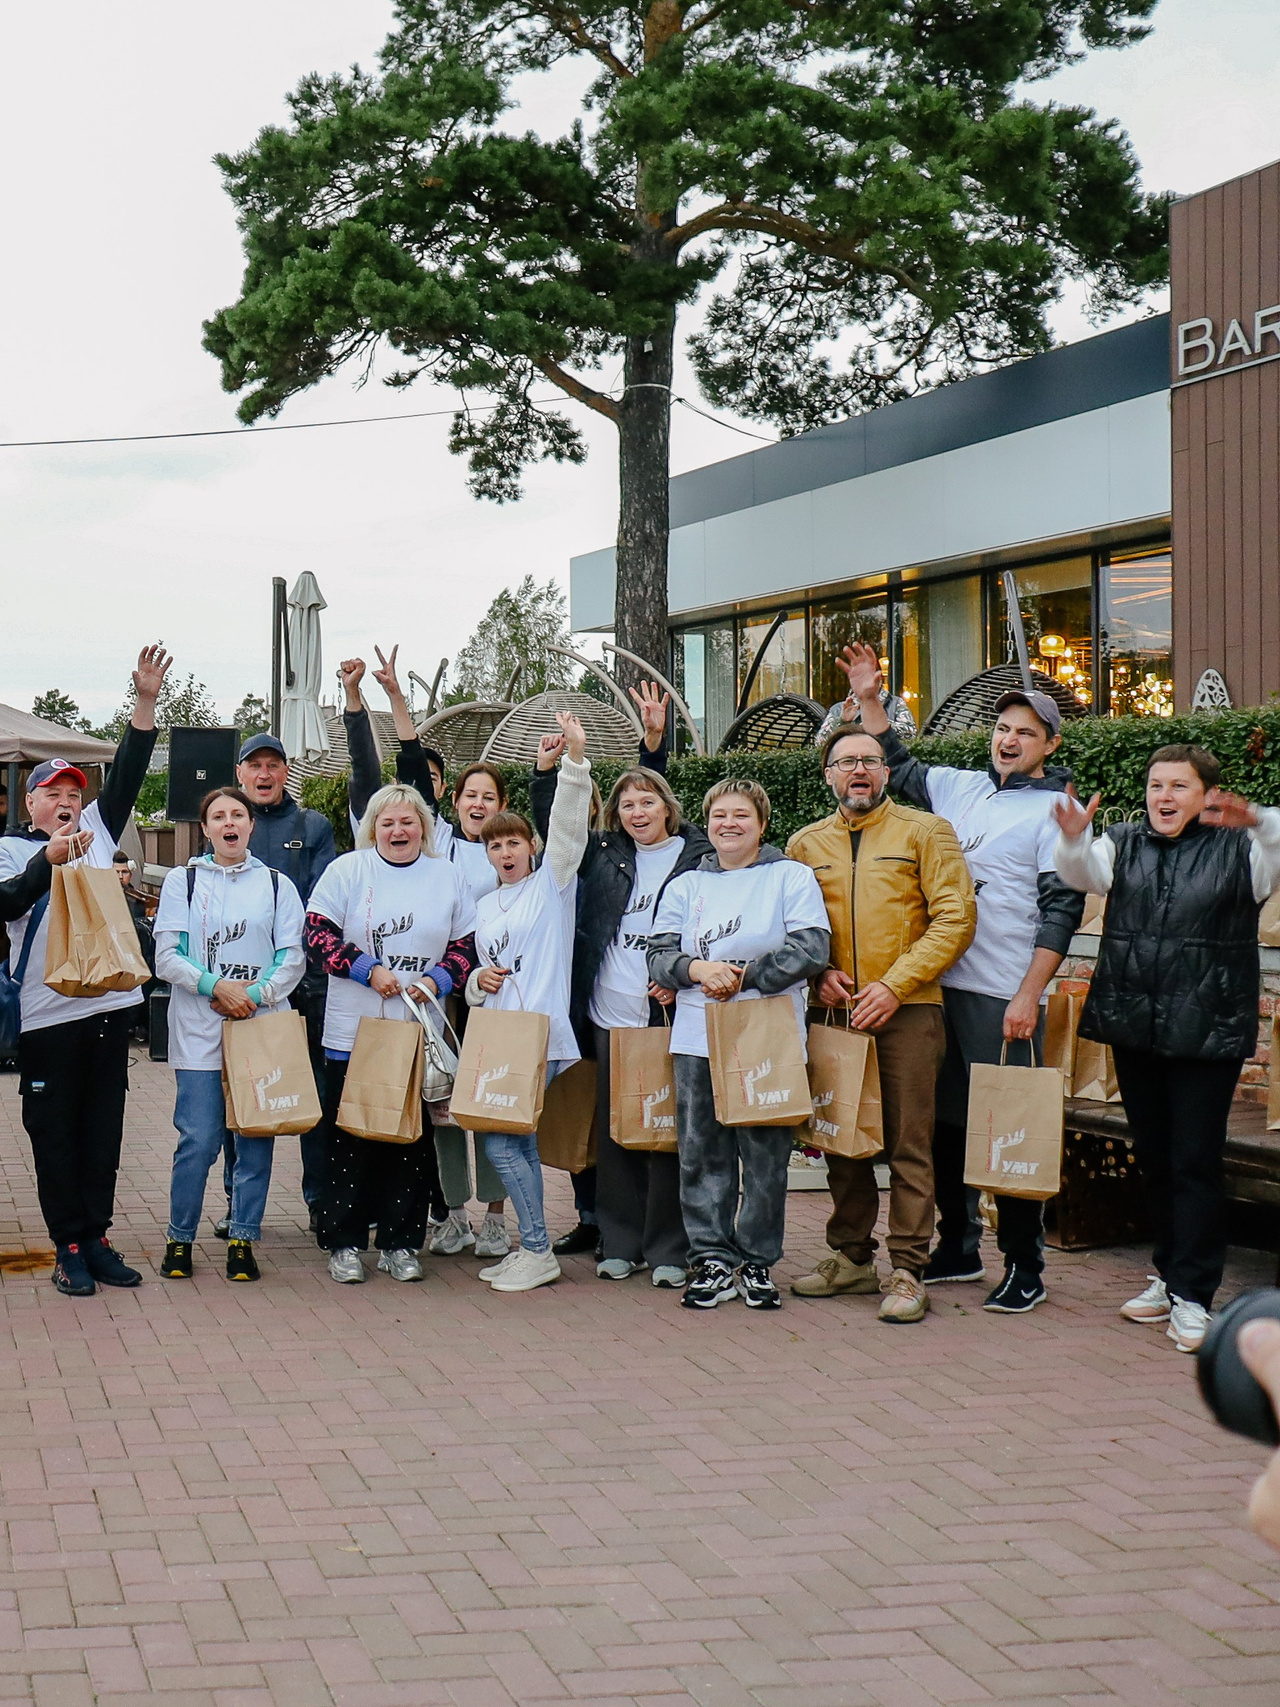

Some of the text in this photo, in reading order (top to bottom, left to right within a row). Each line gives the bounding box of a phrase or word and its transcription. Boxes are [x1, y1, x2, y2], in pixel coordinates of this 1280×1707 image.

[1178, 304, 1280, 376] BAR
[623, 933, 649, 951] УМ
[387, 955, 431, 972] УМТ
[219, 963, 262, 981] УМТ
[268, 1094, 300, 1110] УМТ
[484, 1092, 519, 1108] УМТ
[757, 1089, 791, 1105] УМТ
[652, 1115, 676, 1128] УМ
[815, 1118, 840, 1137] УМТ
[1002, 1160, 1040, 1175] УМТ
